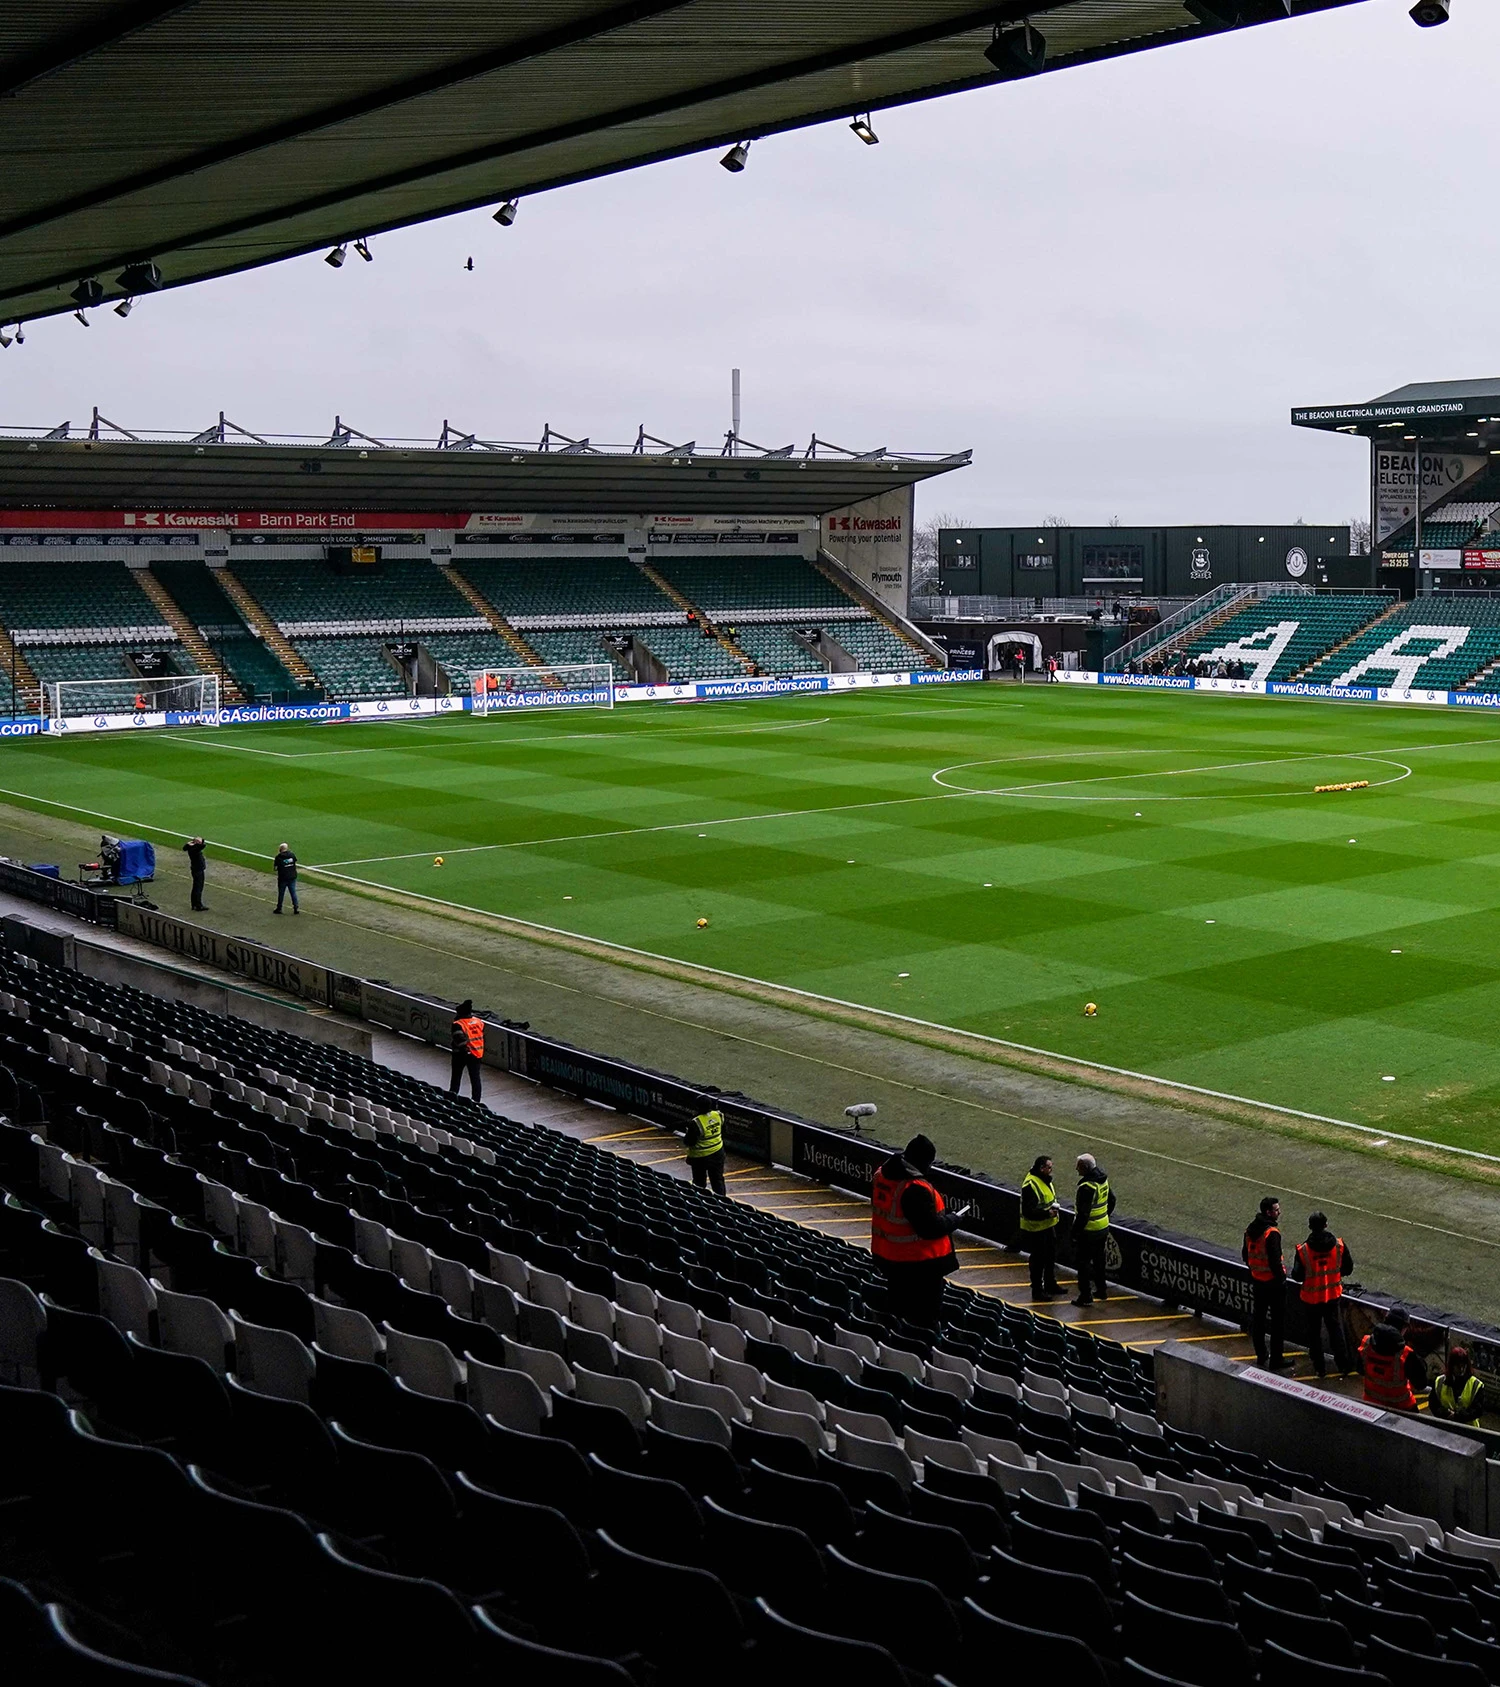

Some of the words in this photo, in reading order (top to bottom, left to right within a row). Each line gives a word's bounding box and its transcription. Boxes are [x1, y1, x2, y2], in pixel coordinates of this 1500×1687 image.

[1309, 411, 1335, 420] BEACON
[1336, 408, 1374, 418] ELECTRICAL
[1375, 406, 1415, 416] MAYFLOWER
[1416, 403, 1464, 413] GRANDSTAND
[1380, 473, 1443, 486] ELECTCAL
[165, 513, 239, 526] Kawasaki
[260, 514, 292, 526] Barn
[296, 514, 327, 526] Park
[330, 514, 355, 526] End
[853, 516, 901, 530] Kawasaki
[829, 534, 857, 544] Powering
[857, 535, 872, 544] your
[873, 533, 902, 543] potential
[871, 572, 902, 583] Plymouth
[705, 679, 821, 696] www.GAsolicitors.com
[1103, 674, 1190, 689] www.GAsolicitors.com
[473, 690, 608, 709] www.GAsolicitors.com
[1272, 683, 1372, 699] www.GAsolicitors.com
[179, 706, 340, 725] wwwGAsolicitors.com
[138, 913, 222, 964] MICHAEL
[226, 942, 301, 993] SPIERS
[540, 1055, 584, 1085] BEAUMONT
[586, 1071, 632, 1100] DRYLINING
[634, 1086, 649, 1106] LTD
[802, 1142, 873, 1183] Mercedes-B
[1140, 1250, 1200, 1281] CORNISH
[1203, 1269, 1255, 1298] PASTIES
[1140, 1264, 1149, 1280] &
[1153, 1270, 1213, 1301] SAVOURY
[1245, 1370, 1263, 1381] PLEASE
[1282, 1382, 1302, 1394] SEATED
[1306, 1390, 1318, 1398] DO
[1319, 1393, 1335, 1404] NOT
[1333, 1397, 1349, 1409] LEAN
[1345, 1403, 1362, 1414] OVER
[1362, 1408, 1377, 1419] WALL
